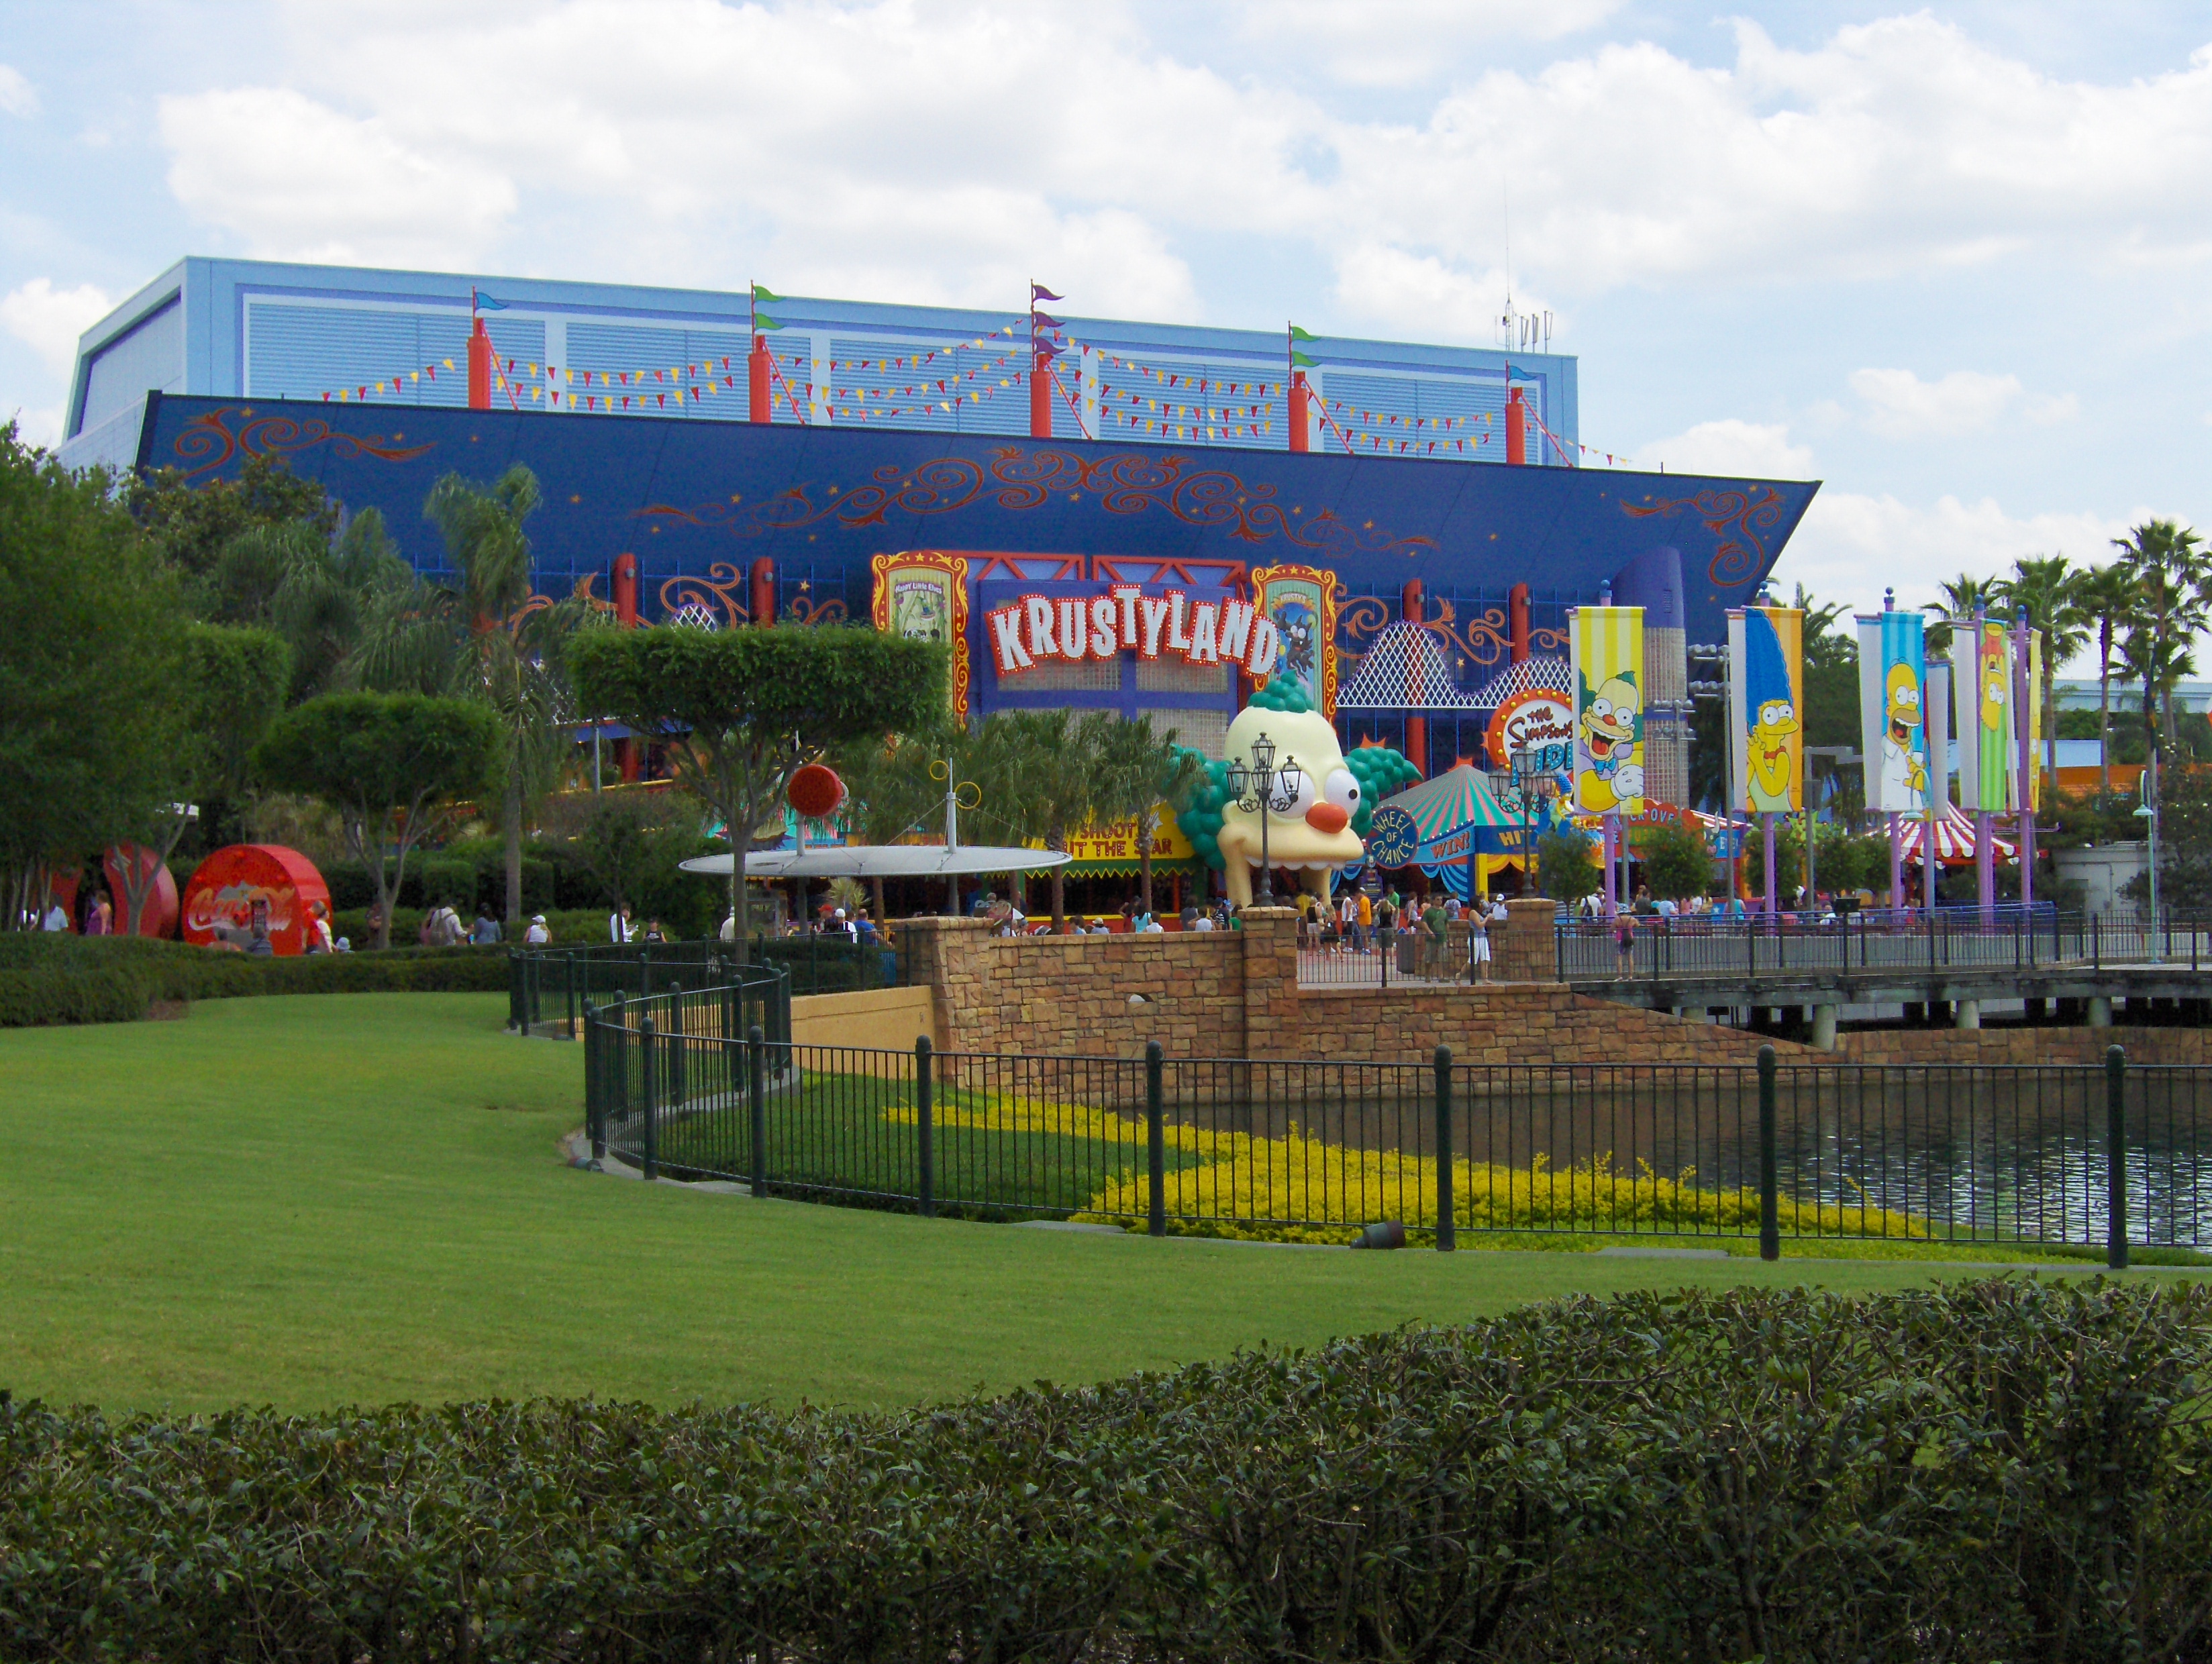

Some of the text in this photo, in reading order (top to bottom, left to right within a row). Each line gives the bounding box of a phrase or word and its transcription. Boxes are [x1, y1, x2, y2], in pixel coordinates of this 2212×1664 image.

[985, 583, 1280, 677] KRUSTYLAND
[1372, 811, 1411, 834] WHEEL
[1063, 838, 1173, 857] UT THE SAR
[1387, 832, 1397, 842] OF
[1431, 831, 1470, 859] WIN!
[1372, 838, 1414, 864] CHANCE
[188, 886, 295, 931] CocaCola
